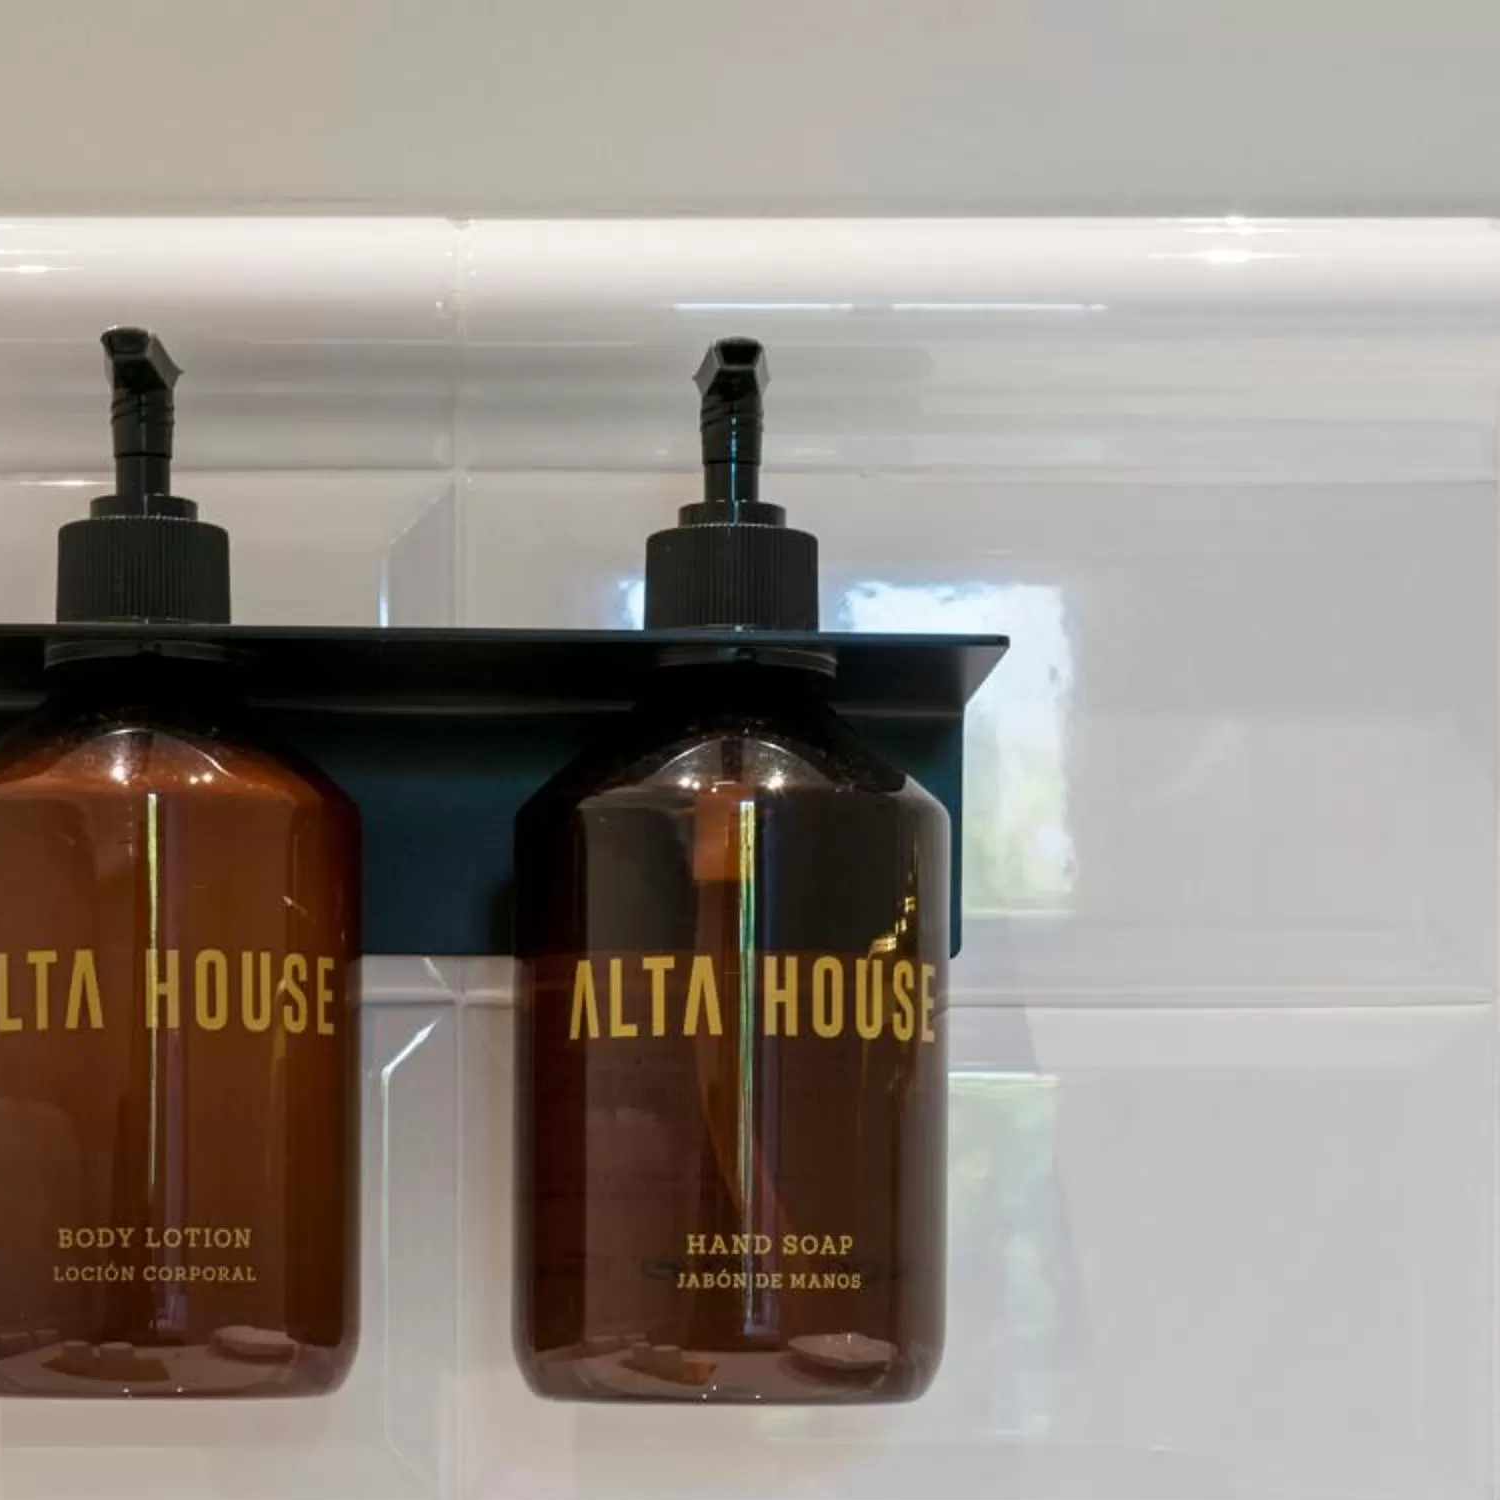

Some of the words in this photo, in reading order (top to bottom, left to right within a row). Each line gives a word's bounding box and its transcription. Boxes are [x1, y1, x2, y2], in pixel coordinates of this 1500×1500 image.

[145, 949, 335, 1035] HOUSE
[569, 955, 723, 1040] ALTA
[764, 955, 935, 1042] HOUSE
[57, 1227, 135, 1249] BODY
[144, 1227, 253, 1249] LOTION
[687, 1233, 772, 1255] HAND
[782, 1234, 854, 1255] SOAP
[53, 1263, 135, 1282] LOCIÓN
[143, 1265, 257, 1282] CORPORAL
[676, 1269, 748, 1289] JABÓN
[755, 1273, 783, 1289] DE
[789, 1273, 861, 1289] MANOS
